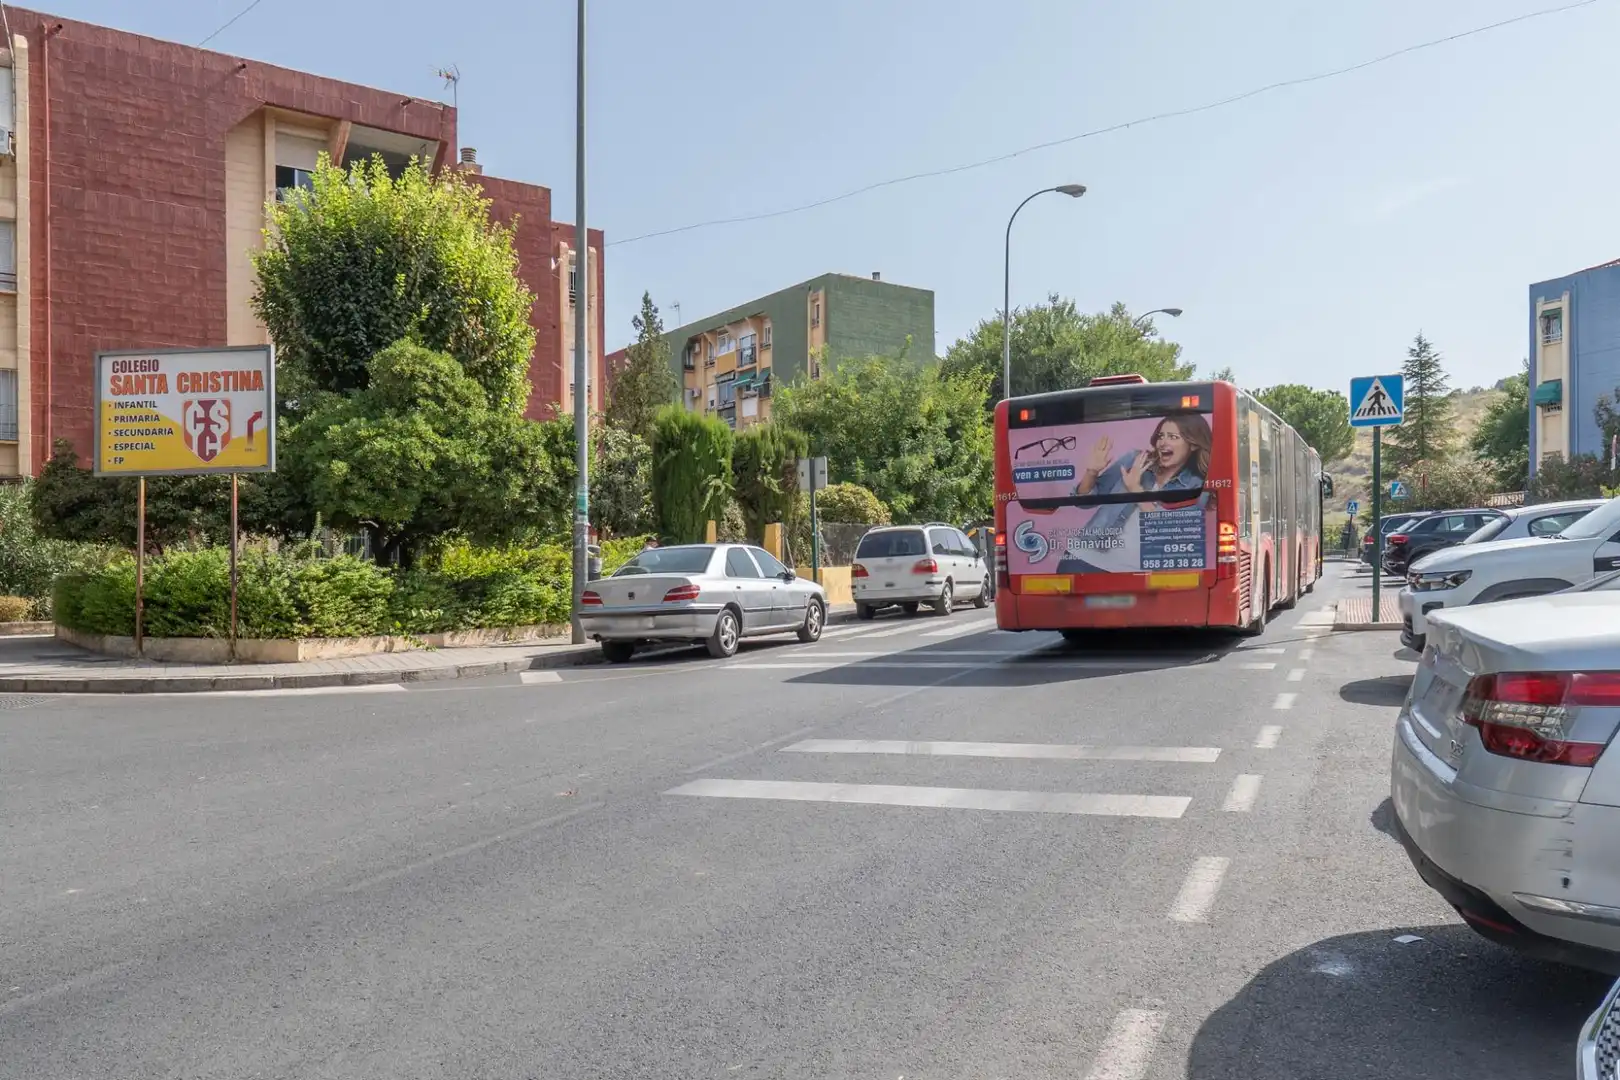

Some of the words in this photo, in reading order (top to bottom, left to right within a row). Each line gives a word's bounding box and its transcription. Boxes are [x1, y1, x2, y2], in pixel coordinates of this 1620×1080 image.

[112, 359, 159, 373] COLEGIO
[110, 374, 169, 396] SANTA
[176, 370, 264, 393] CRISTINA
[114, 400, 158, 410] INFANTIL
[114, 414, 161, 423] PRIMARIA
[114, 427, 174, 437] SECUNDARIA
[114, 443, 155, 451] ESPECIAL
[1015, 471, 1031, 480] ven
[1033, 471, 1040, 479] a
[1041, 468, 1073, 478] vernos
[1205, 479, 1232, 488] 11612
[1049, 539, 1064, 550] Dr.
[1067, 536, 1125, 550] Benavides
[1163, 543, 1195, 553] 695€
[1142, 559, 1161, 569] 958
[1162, 559, 1175, 568] 28
[1176, 558, 1190, 568] 38
[1191, 558, 1204, 567] 28
